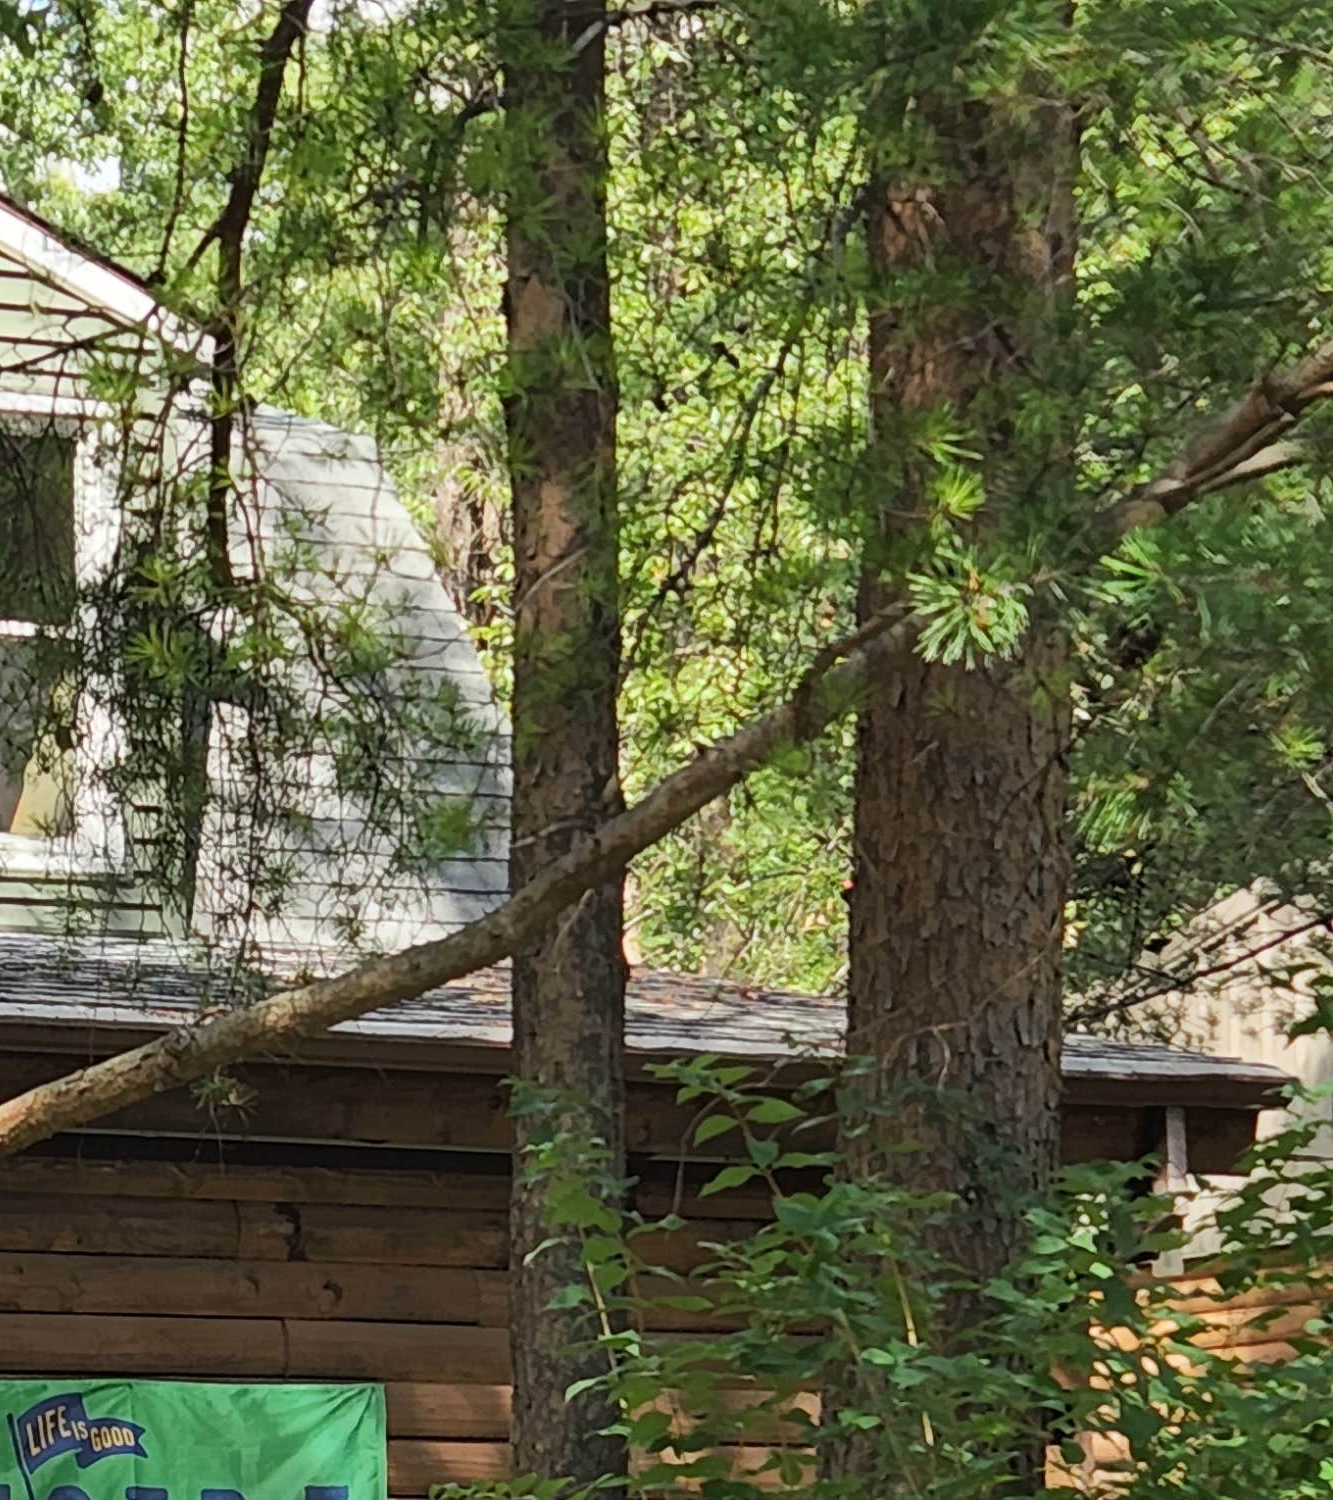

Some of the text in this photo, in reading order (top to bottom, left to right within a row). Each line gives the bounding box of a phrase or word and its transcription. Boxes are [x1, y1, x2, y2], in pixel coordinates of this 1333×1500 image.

[25, 1404, 136, 1457] LIFE IS GOOD
